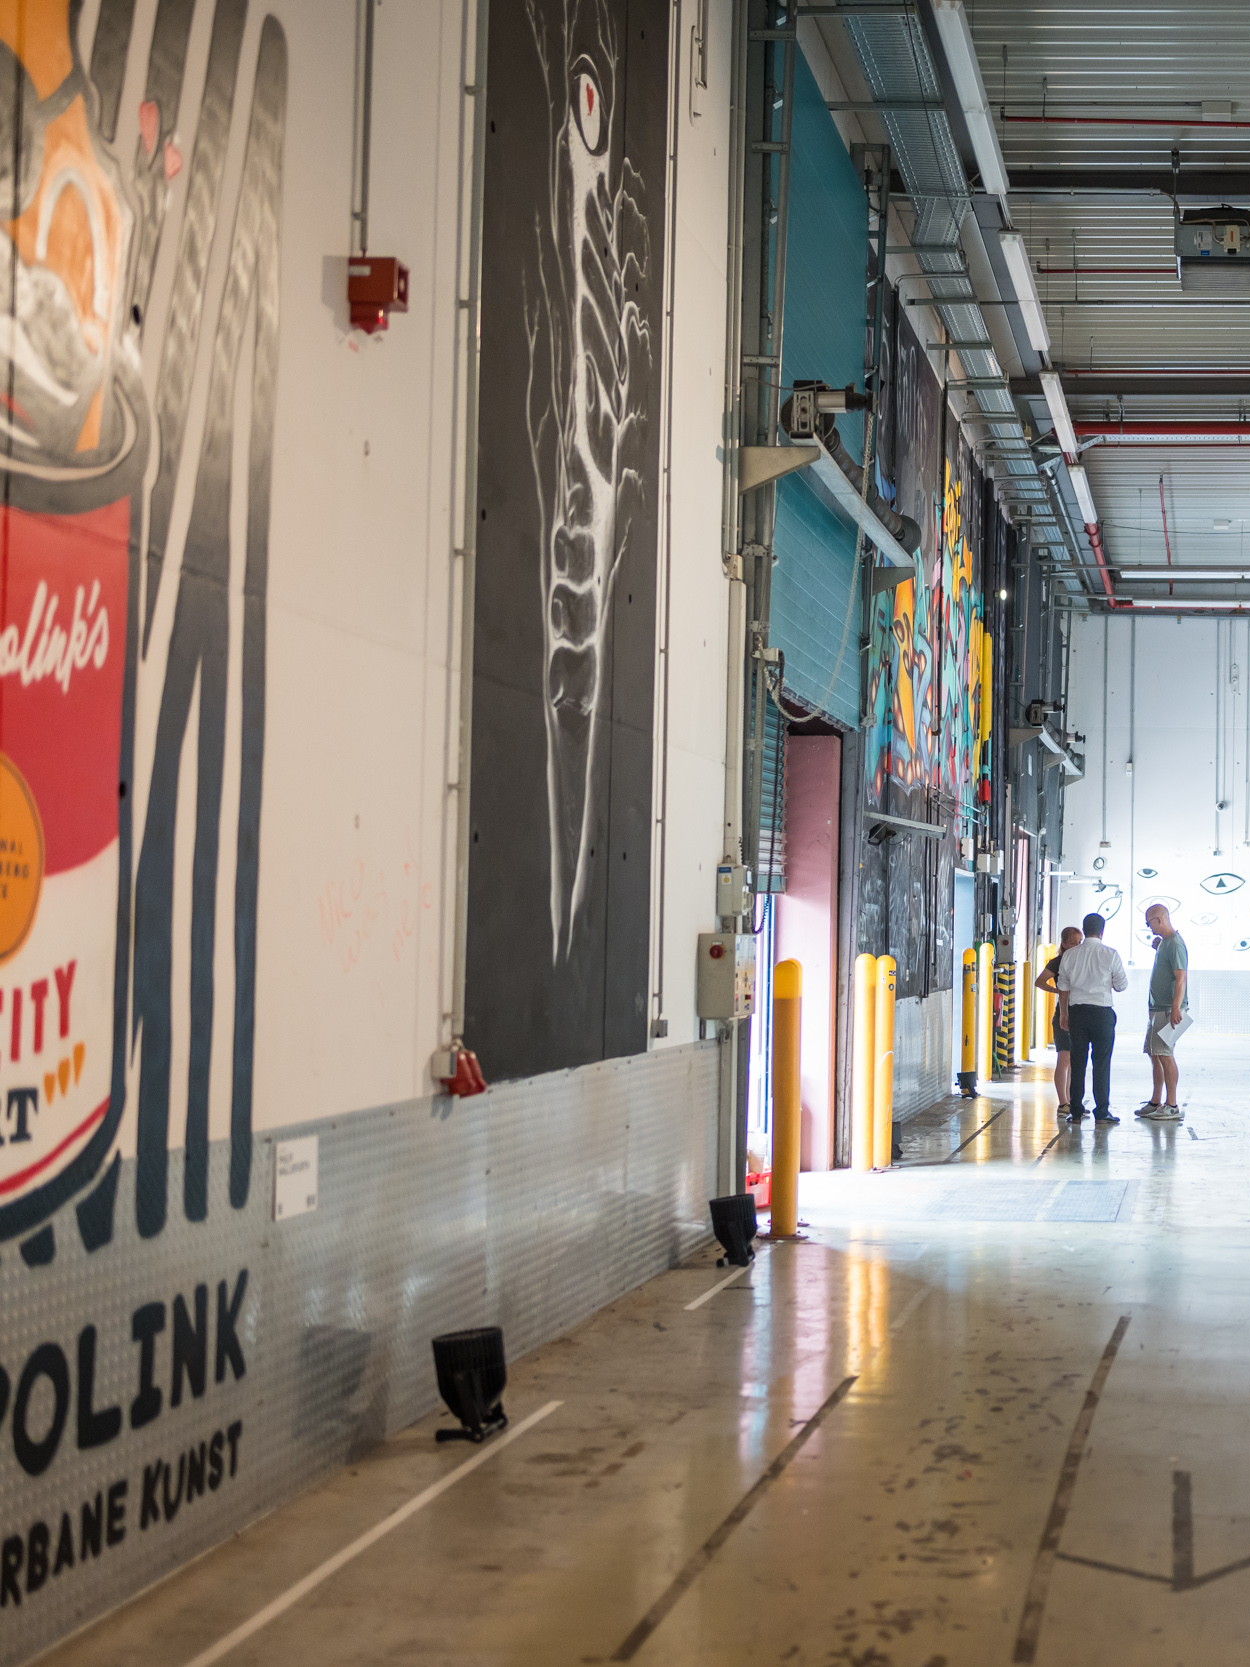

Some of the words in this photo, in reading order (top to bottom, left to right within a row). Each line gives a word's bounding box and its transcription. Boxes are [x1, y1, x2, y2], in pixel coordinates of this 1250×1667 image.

[0, 959, 77, 1064] ITY
[0, 1087, 39, 1147] T
[139, 1419, 243, 1532] KUNST
